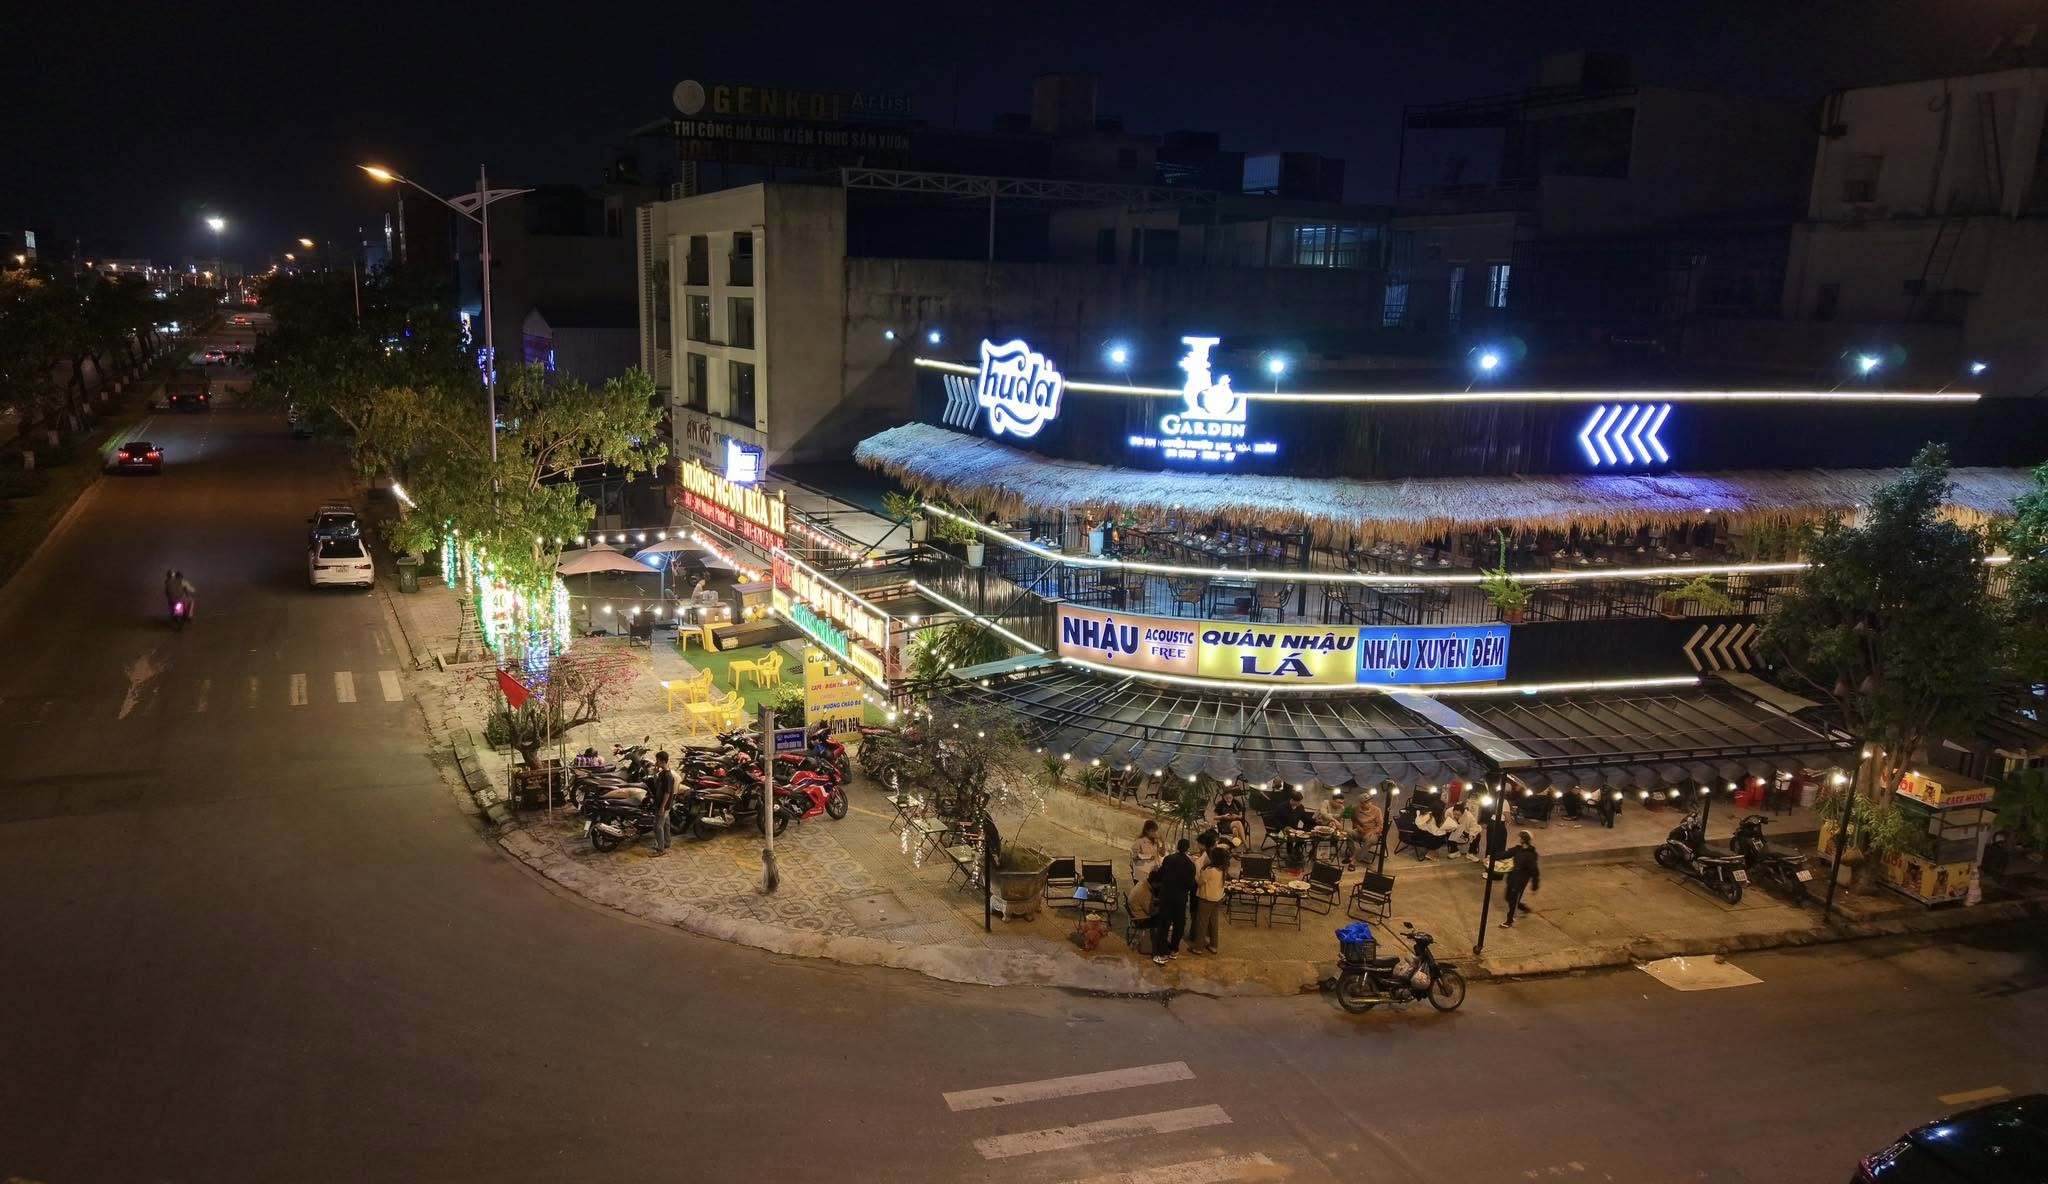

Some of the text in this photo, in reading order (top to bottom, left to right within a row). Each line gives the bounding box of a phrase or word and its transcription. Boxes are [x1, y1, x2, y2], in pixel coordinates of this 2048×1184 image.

[1161, 415, 1247, 437] GARDEN
[1063, 616, 1195, 659] NHẬU ACOUSTIC
[1202, 629, 1356, 655] QUÁN NHẬU
[1151, 646, 1186, 661] FREE
[1240, 652, 1314, 678] LÁ
[1362, 630, 1506, 679] NHẬU XUYÊN ĐÊM
